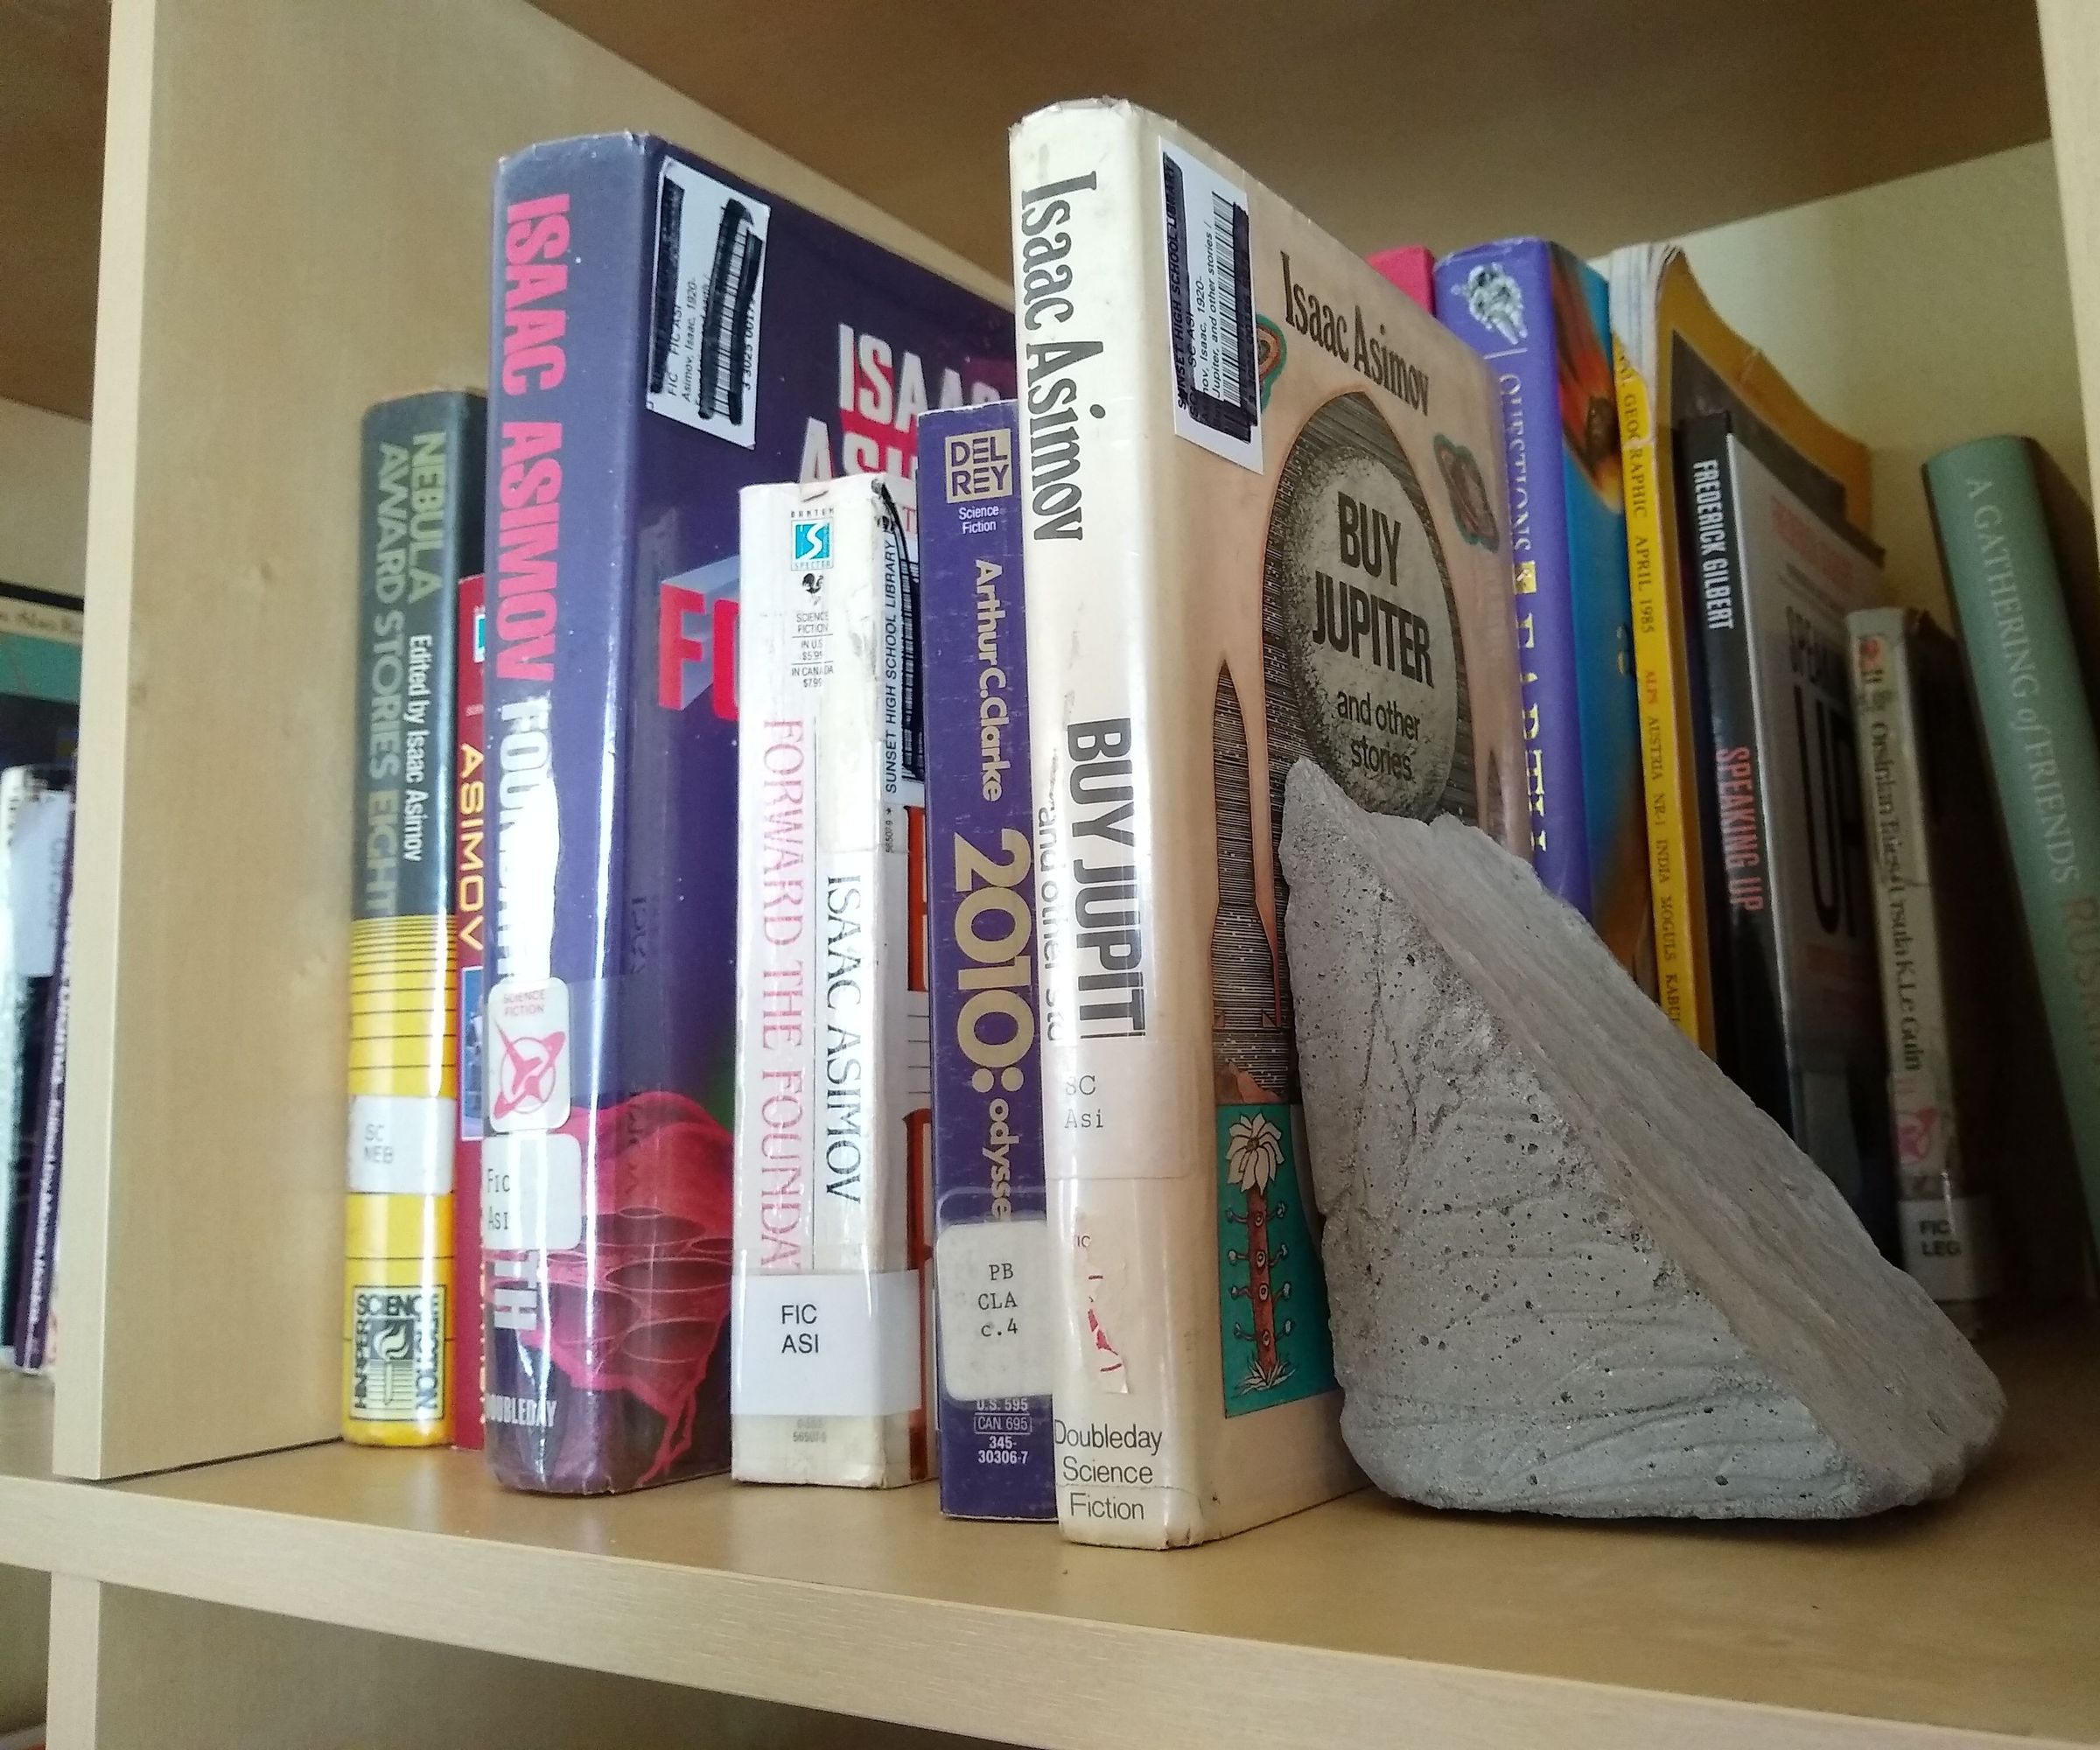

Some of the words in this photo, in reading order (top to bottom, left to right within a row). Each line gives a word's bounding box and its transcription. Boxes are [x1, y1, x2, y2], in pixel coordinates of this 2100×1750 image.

[1021, 171, 1097, 332] Isaac
[1204, 232, 1215, 276] stories
[502, 193, 570, 396] ISAAC
[1208, 278, 1217, 313] other
[1208, 315, 1219, 343] and
[1280, 250, 1350, 363] Isaac
[1354, 304, 1430, 416] Asimov
[668, 372, 679, 397] FIC
[950, 436, 1008, 468] DEL
[1026, 340, 1106, 541] Asimov
[951, 464, 1010, 497] REY
[1967, 480, 1993, 500] A
[375, 441, 409, 605] AWARD
[408, 431, 446, 605] NEBULA
[959, 506, 999, 521] Science
[962, 520, 997, 536] Fiction
[1692, 458, 1727, 556] FREDERICK
[496, 421, 563, 681] ASIMOV
[1337, 491, 1402, 586] BUY
[1634, 535, 1653, 594] APRIL
[884, 540, 897, 608] LIBRARY
[1702, 557, 1735, 632] GILBERT
[975, 559, 1007, 670] Arthur
[1640, 598, 1656, 635] 1985
[1974, 504, 2040, 698] GATHERING
[885, 614, 897, 680] SCHOOL
[1312, 570, 1435, 689] JUPITER
[407, 634, 432, 697] Edited
[368, 609, 405, 781] STORIES
[404, 701, 430, 724] by
[886, 680, 898, 725] HIGH
[1336, 690, 1372, 728] and
[1375, 701, 1421, 742] other
[405, 728, 430, 784] Isaac
[886, 732, 898, 794] SUNSET
[980, 697, 1012, 802] Clarke
[1350, 736, 1414, 782] stories
[1066, 718, 1136, 847] BUY
[402, 788, 430, 862] Asimov
[762, 720, 804, 946] FORWARD
[2025, 739, 2080, 885] FRIENDS
[458, 742, 485, 952] ASIMOV
[1729, 876, 1763, 912] UP
[826, 875, 862, 1009] ISAAC
[503, 989, 546, 1004] SCIENCE
[504, 1004, 545, 1017] FICTION
[762, 961, 804, 1050] THE
[365, 1124, 385, 1143] SC
[825, 1023, 862, 1204] ASIMOV
[1064, 1108, 1103, 1129] Asi
[363, 1145, 394, 1165] NEB
[989, 1263, 1015, 1281] PB
[781, 1304, 818, 1325] FIC
[977, 1292, 1018, 1311] CLA
[780, 1334, 820, 1354] ASI
[1004, 1397, 1029, 1411] 595
[1005, 1416, 1029, 1432] 695
[977, 1449, 1029, 1465] 30306-7
[1054, 1419, 1163, 1456] Doubleday
[1062, 1455, 1153, 1484] Science
[1069, 1492, 1144, 1521] Fiction
